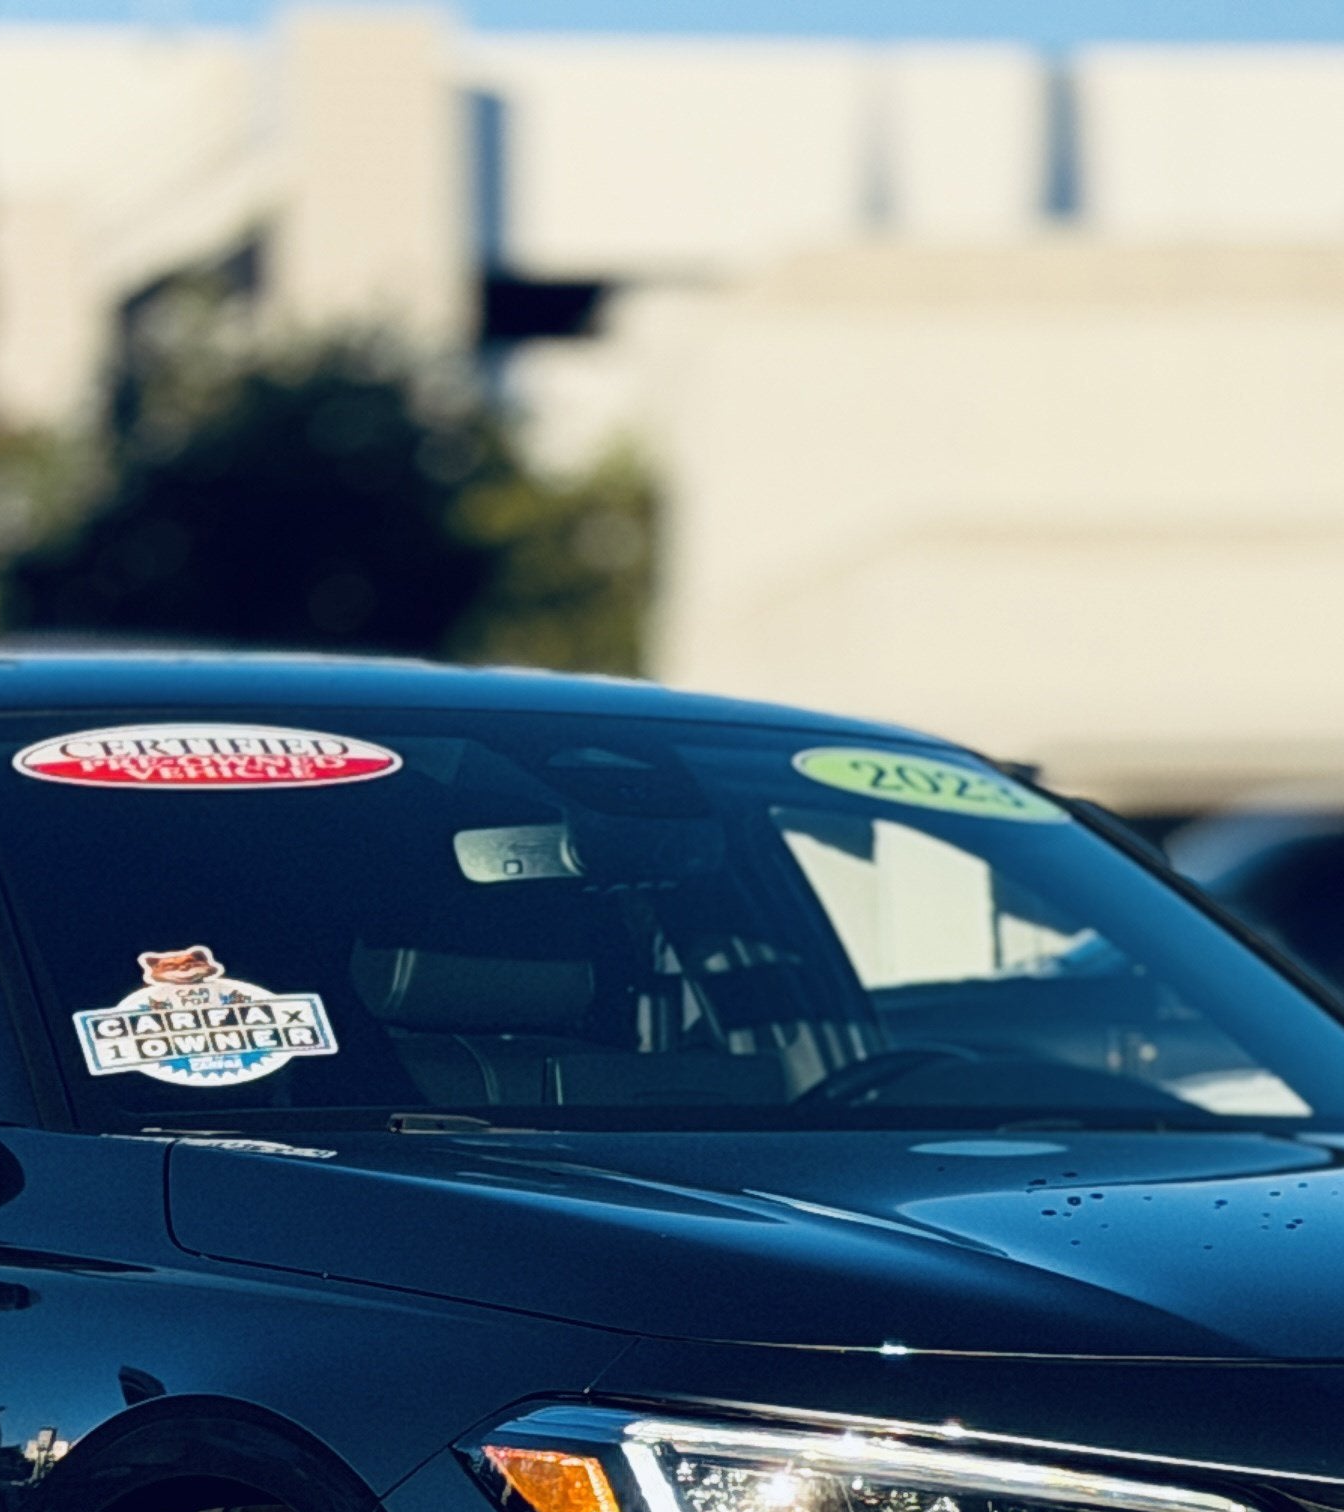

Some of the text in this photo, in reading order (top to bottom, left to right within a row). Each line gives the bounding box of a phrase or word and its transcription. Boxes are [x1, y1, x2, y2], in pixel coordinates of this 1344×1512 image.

[59, 737, 350, 759] CERTIFIED
[79, 755, 347, 772] PRE-OWNED
[124, 765, 316, 781] VEHICLE
[97, 1004, 305, 1037] CARFAX
[108, 1026, 316, 1060] 1 OWNER
